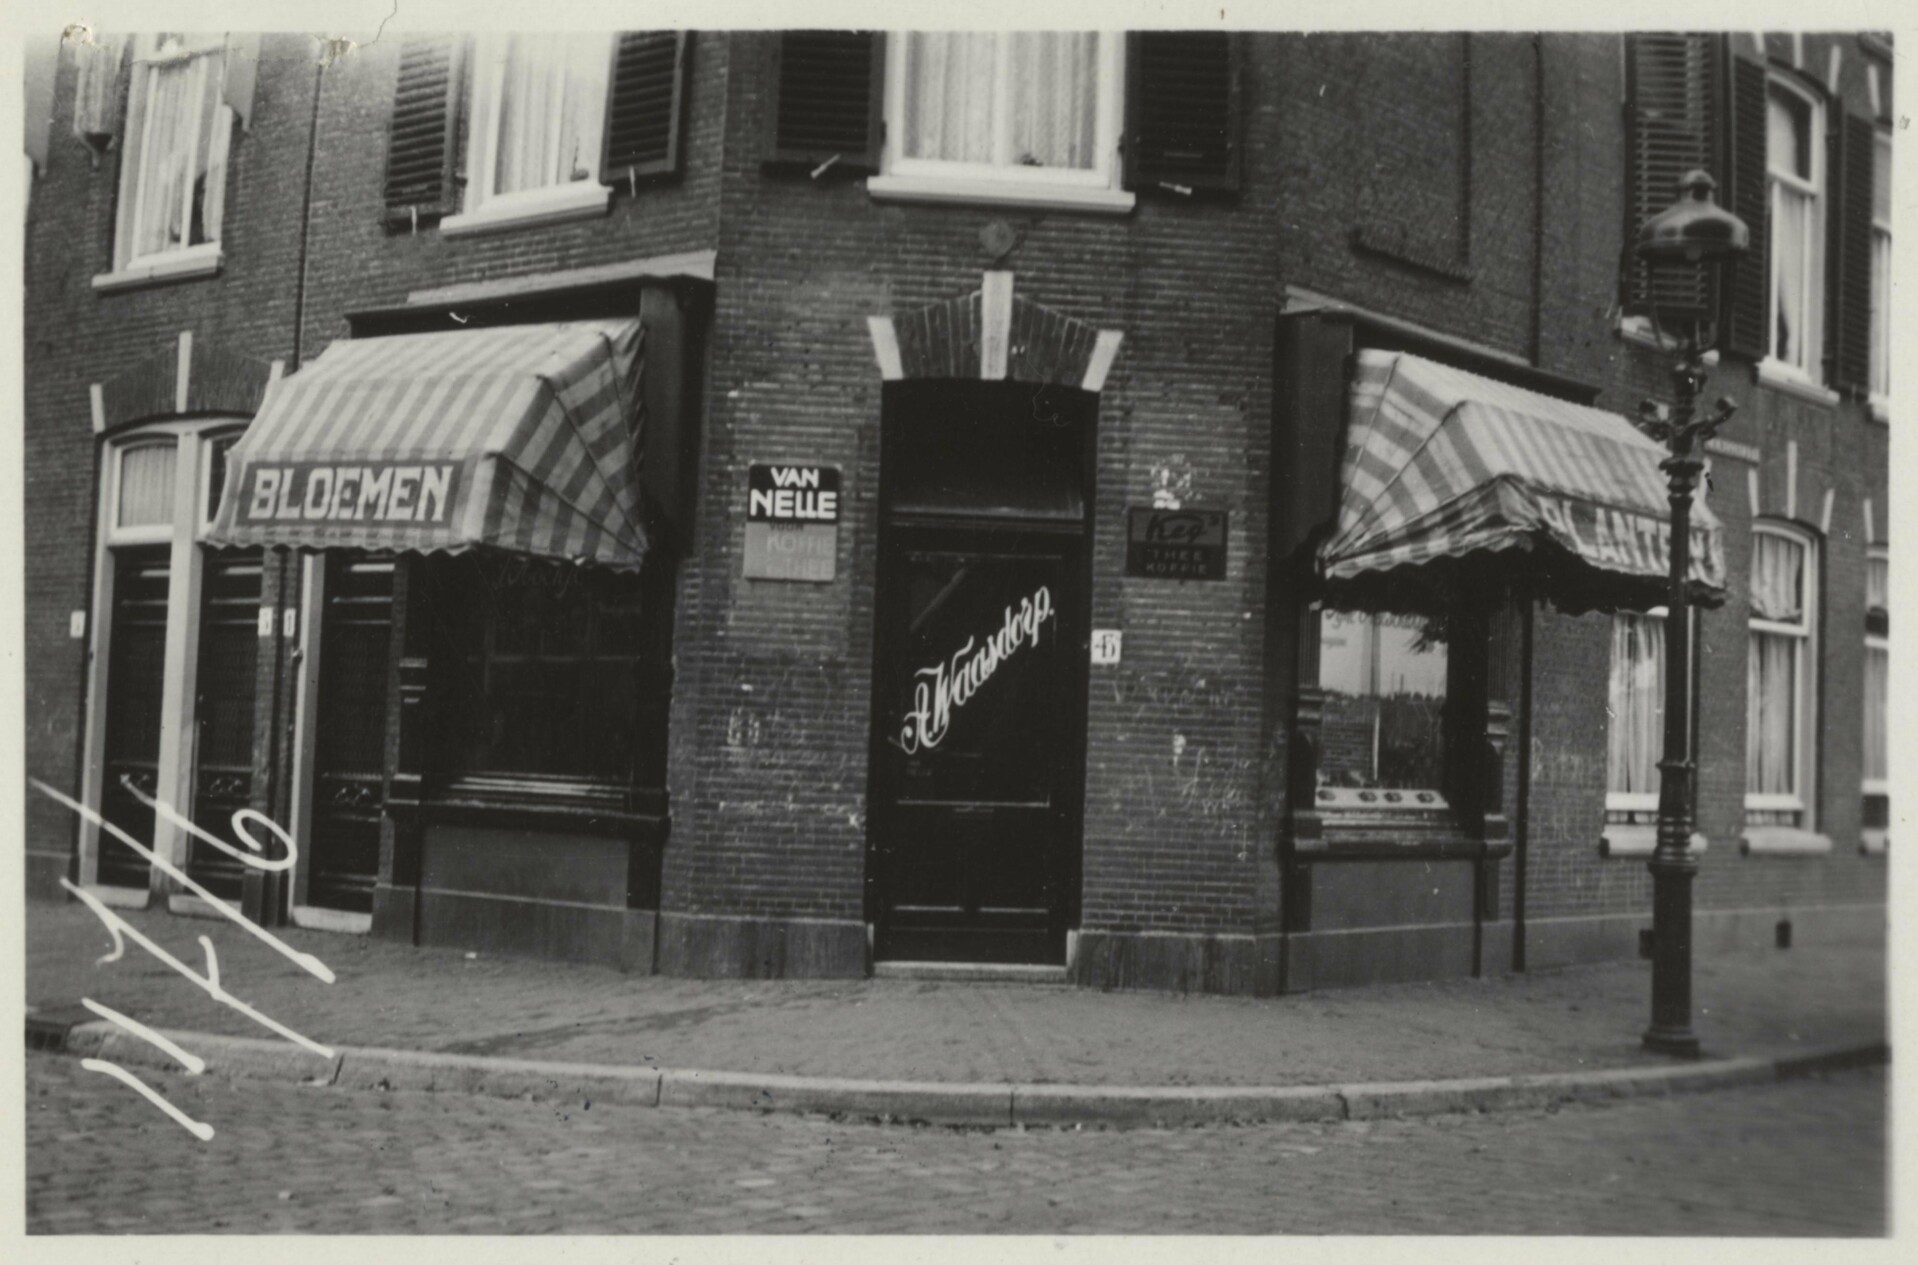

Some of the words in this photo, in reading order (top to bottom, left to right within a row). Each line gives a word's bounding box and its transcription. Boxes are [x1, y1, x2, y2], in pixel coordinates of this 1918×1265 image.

[770, 466, 819, 488] VAN
[248, 465, 453, 522] BLOEMEN
[750, 488, 837, 519] NELLE
